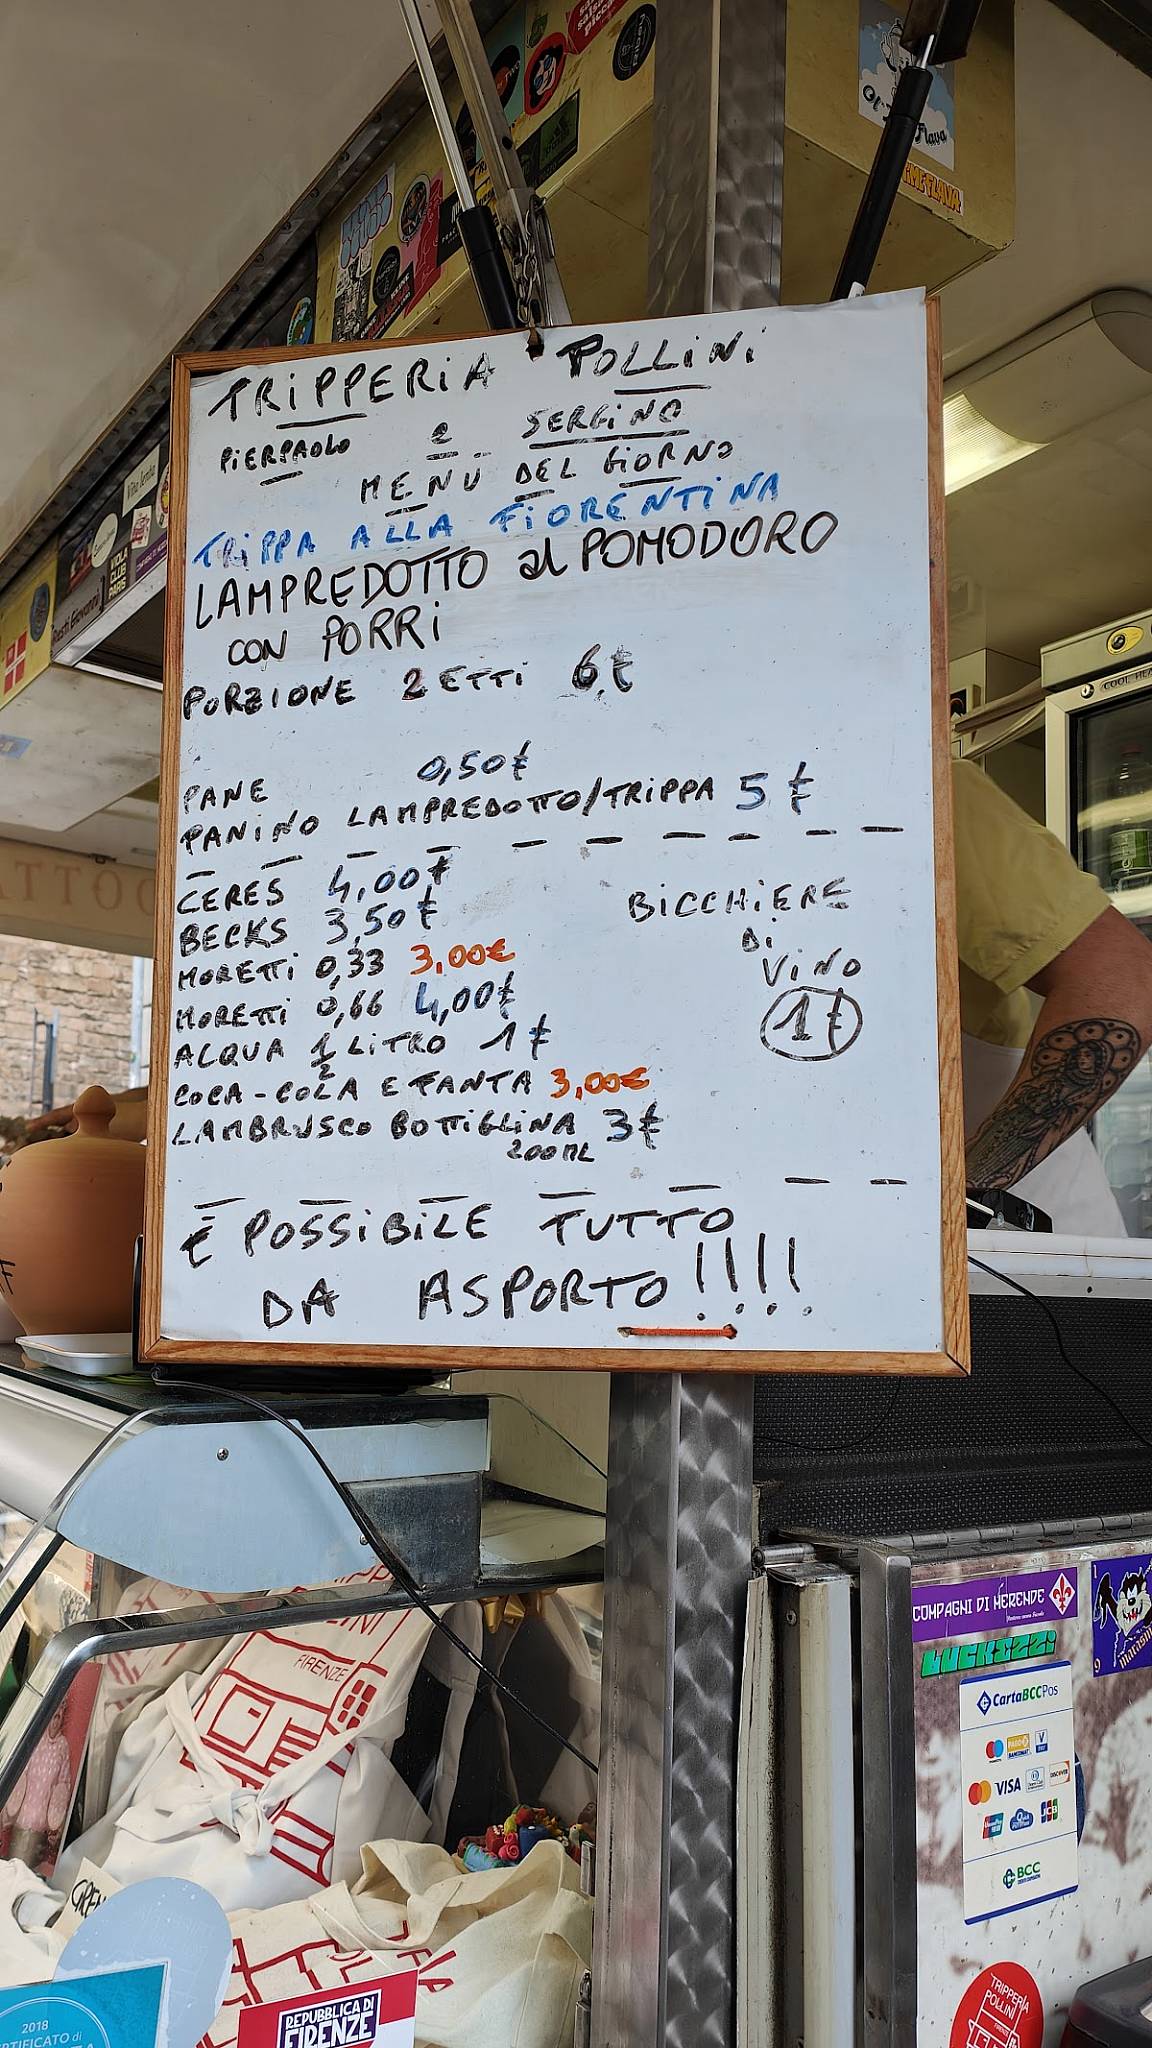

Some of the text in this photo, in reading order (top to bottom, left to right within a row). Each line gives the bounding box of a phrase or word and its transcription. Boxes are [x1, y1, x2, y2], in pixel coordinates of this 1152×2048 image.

[516, 457, 576, 484] DEL
[351, 514, 453, 549] ALLA
[110, 562, 127, 584] CLUB
[196, 546, 489, 629] LAMPREDOTTO
[582, 511, 839, 571] POMODORO
[228, 630, 288, 667] CON
[183, 675, 356, 720] PORZIONE
[402, 667, 427, 700] 2
[184, 778, 268, 813] PANE
[177, 877, 285, 915] CERES
[179, 917, 288, 957] BECKS
[315, 948, 385, 990] 0,33
[409, 938, 516, 975] 3,00€
[317, 990, 383, 1028] 0,66
[174, 1038, 285, 1069] ACQUA
[381, 1077, 398, 1097] E
[409, 1070, 532, 1096] FANTA
[550, 1066, 651, 1100] 3,00€
[172, 1114, 372, 1146] LAMBRUSCO
[539, 1207, 735, 1246] TUTTO
[263, 1277, 341, 1329] DA
[912, 1597, 973, 1623] COMPAGNI
[977, 1596, 990, 1613] DI
[294, 1654, 349, 1682] FIRENZE
[994, 1777, 1021, 1796] VISA
[1017, 1861, 1040, 1878] BCC
[984, 1989, 1019, 2021] POLLINI
[990, 1972, 1030, 2015] TRIPPERIA
[21, 2020, 49, 2034] 2018
[284, 2010, 374, 2048] FIRENZE
[285, 1996, 374, 2031] REPUBBLICA DI
[72, 2031, 82, 2042] di
